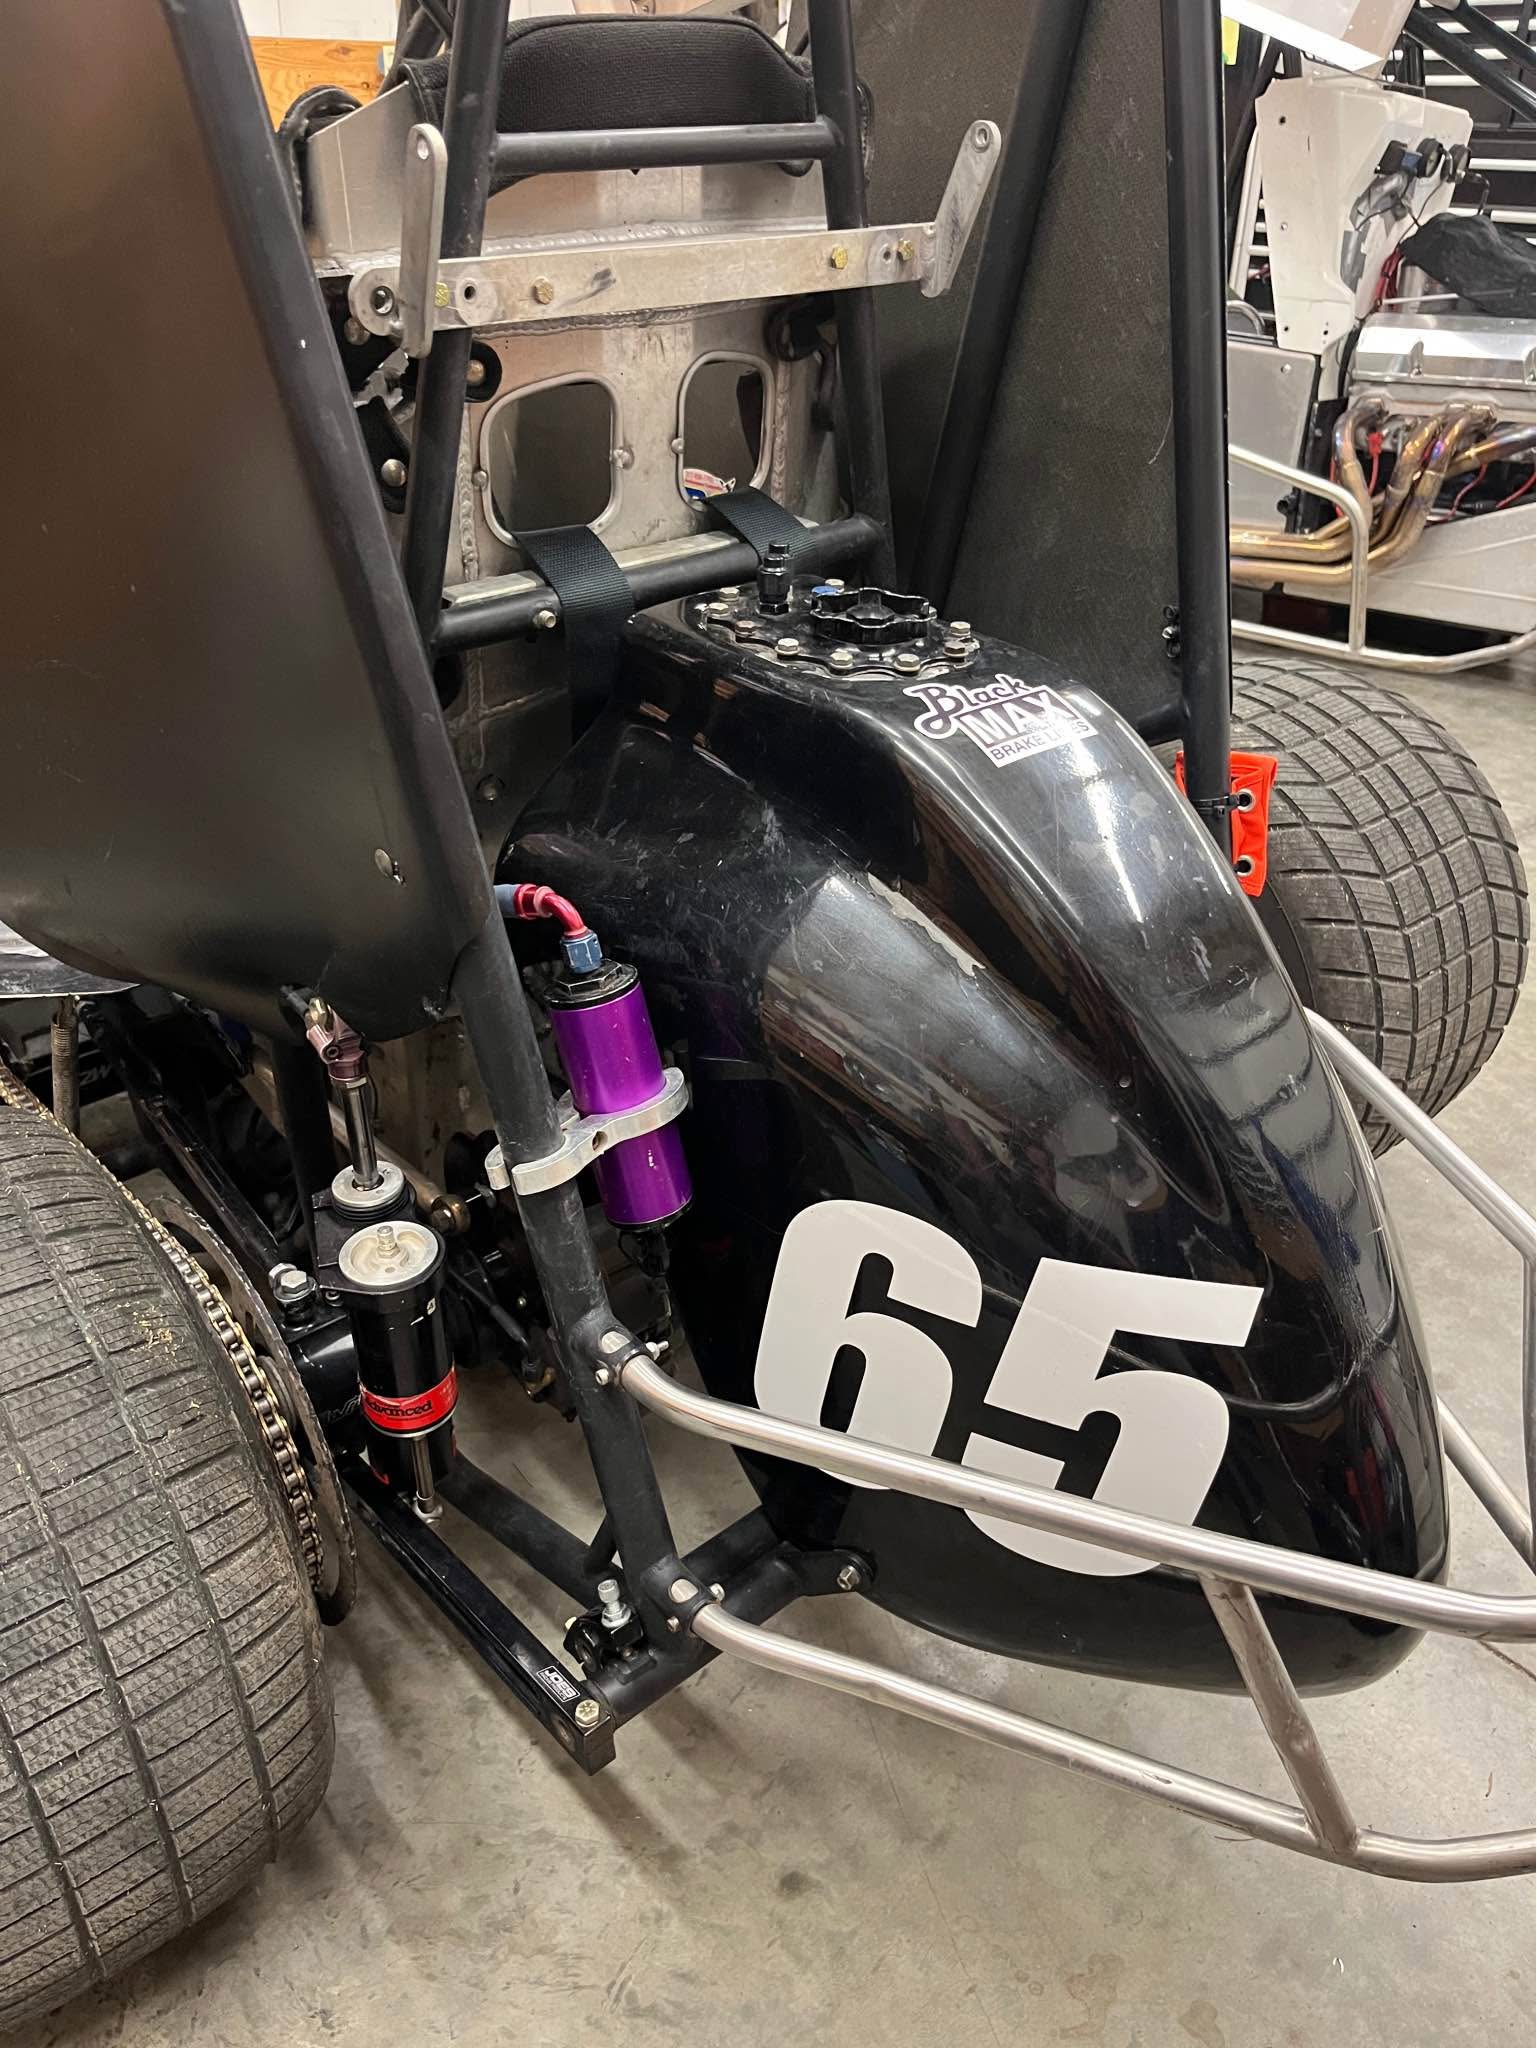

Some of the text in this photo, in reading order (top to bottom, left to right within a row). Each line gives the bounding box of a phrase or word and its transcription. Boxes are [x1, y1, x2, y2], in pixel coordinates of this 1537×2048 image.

[909, 676, 1031, 736] Black
[958, 691, 1075, 744] MAX
[990, 720, 1090, 761] BRAKE LIES
[754, 1200, 1264, 1577] 65
[544, 1670, 577, 1698] JOES
